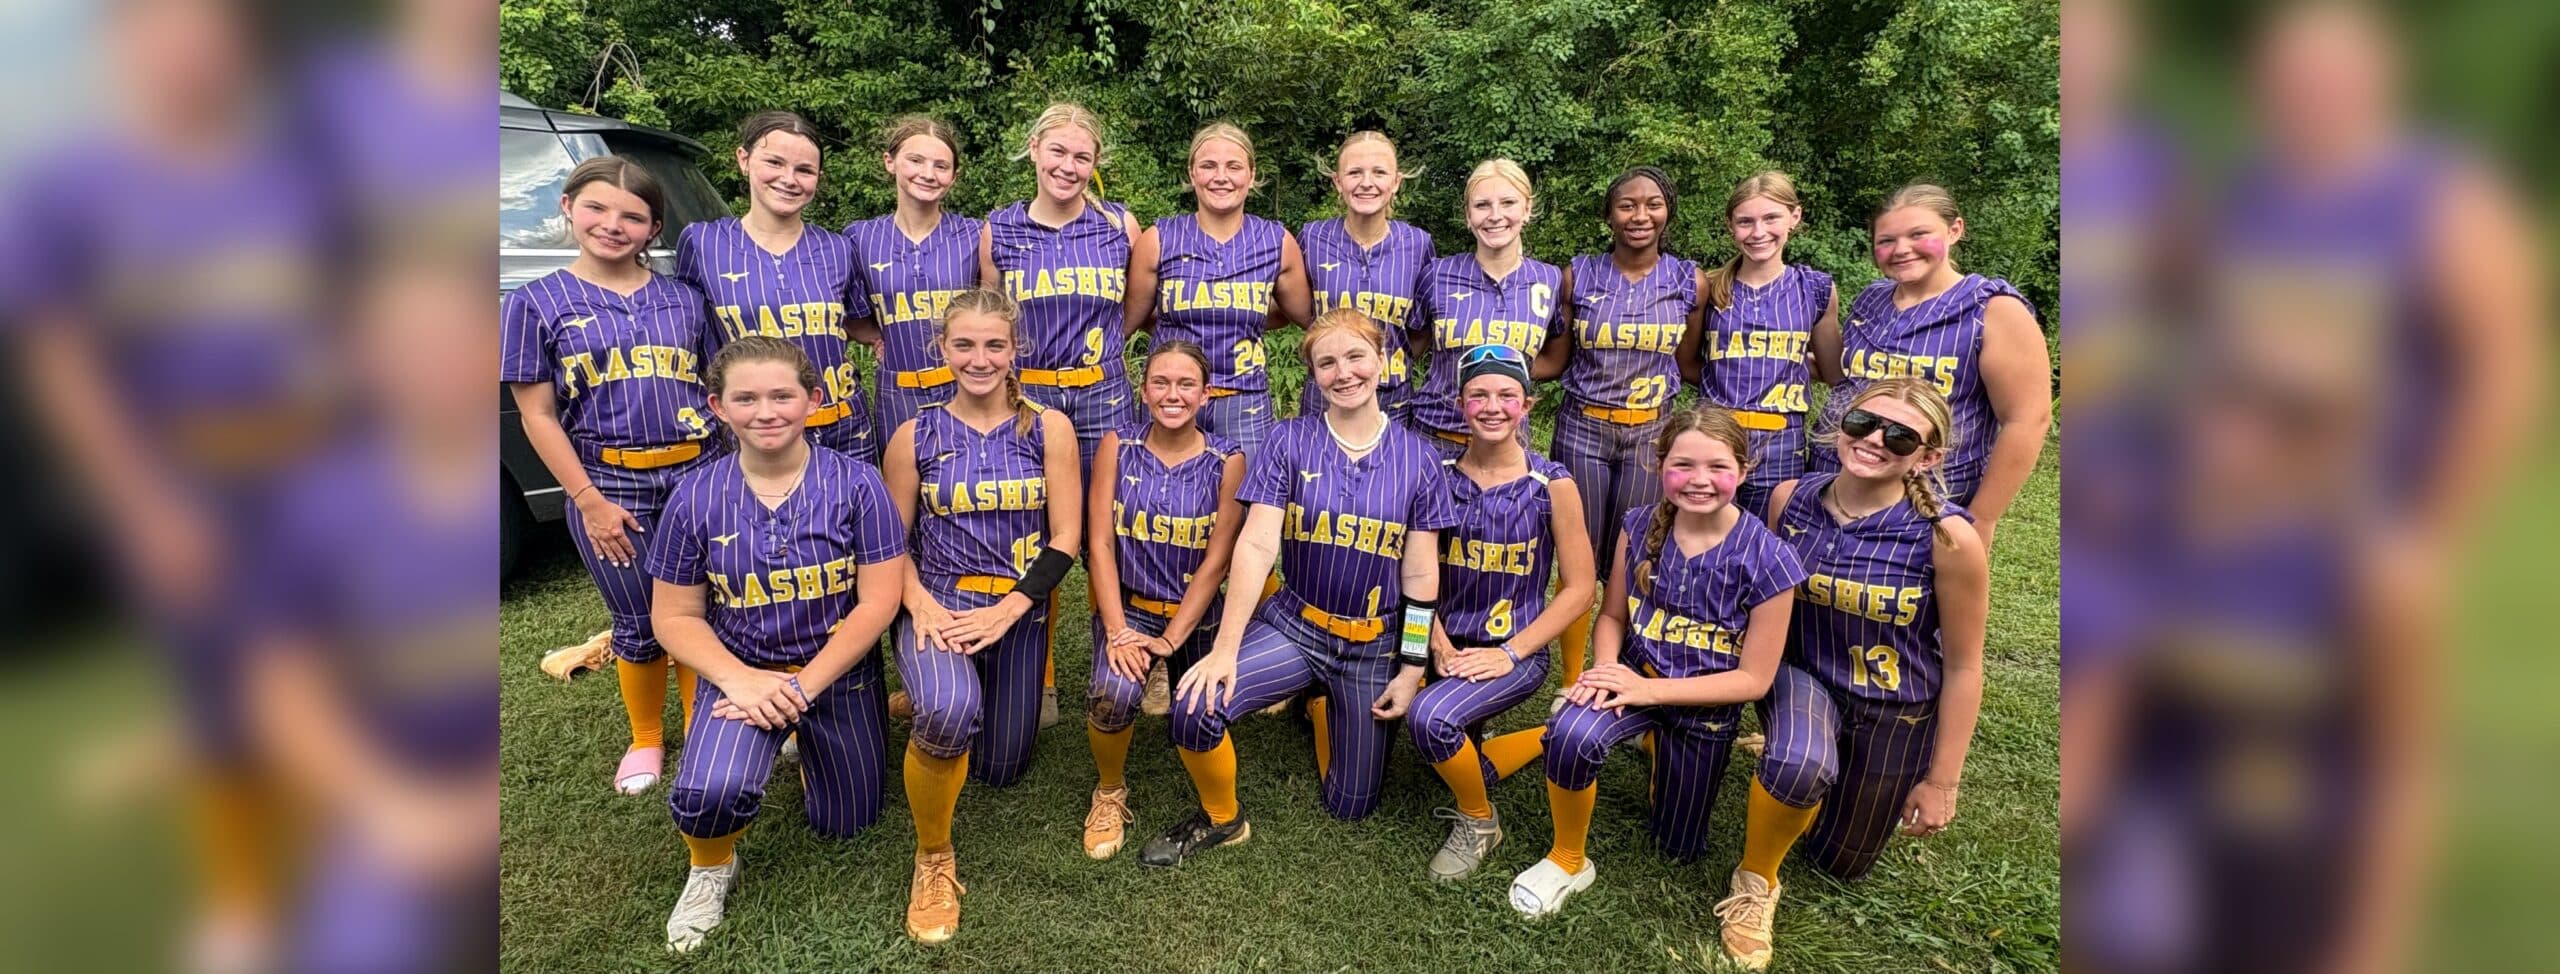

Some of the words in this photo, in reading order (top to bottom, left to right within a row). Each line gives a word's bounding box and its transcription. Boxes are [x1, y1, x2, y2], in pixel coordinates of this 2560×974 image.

[1005, 266, 1126, 304] FLASHES
[1530, 283, 1552, 319] C
[869, 289, 968, 326] FLASH
[1313, 290, 1413, 328] LASHE
[1082, 327, 1104, 366] 9
[1233, 338, 1266, 377] 24
[1433, 318, 1547, 361] FLASHE
[1705, 330, 1811, 365] LASHE
[560, 343, 703, 400] FLASHE
[823, 361, 857, 404] 18
[1841, 346, 1959, 398] ASHES
[1626, 374, 1667, 409] 27
[1761, 383, 1809, 413] 40
[676, 406, 709, 441] 3
[922, 478, 1046, 519] LASHE
[1285, 500, 1408, 560] FLASHES
[1439, 536, 1538, 576] ASHES
[1365, 584, 1383, 617] 1
[1795, 572, 1923, 627] SHES
[1628, 595, 1745, 657] LASHE
[1848, 644, 1902, 692] 13
